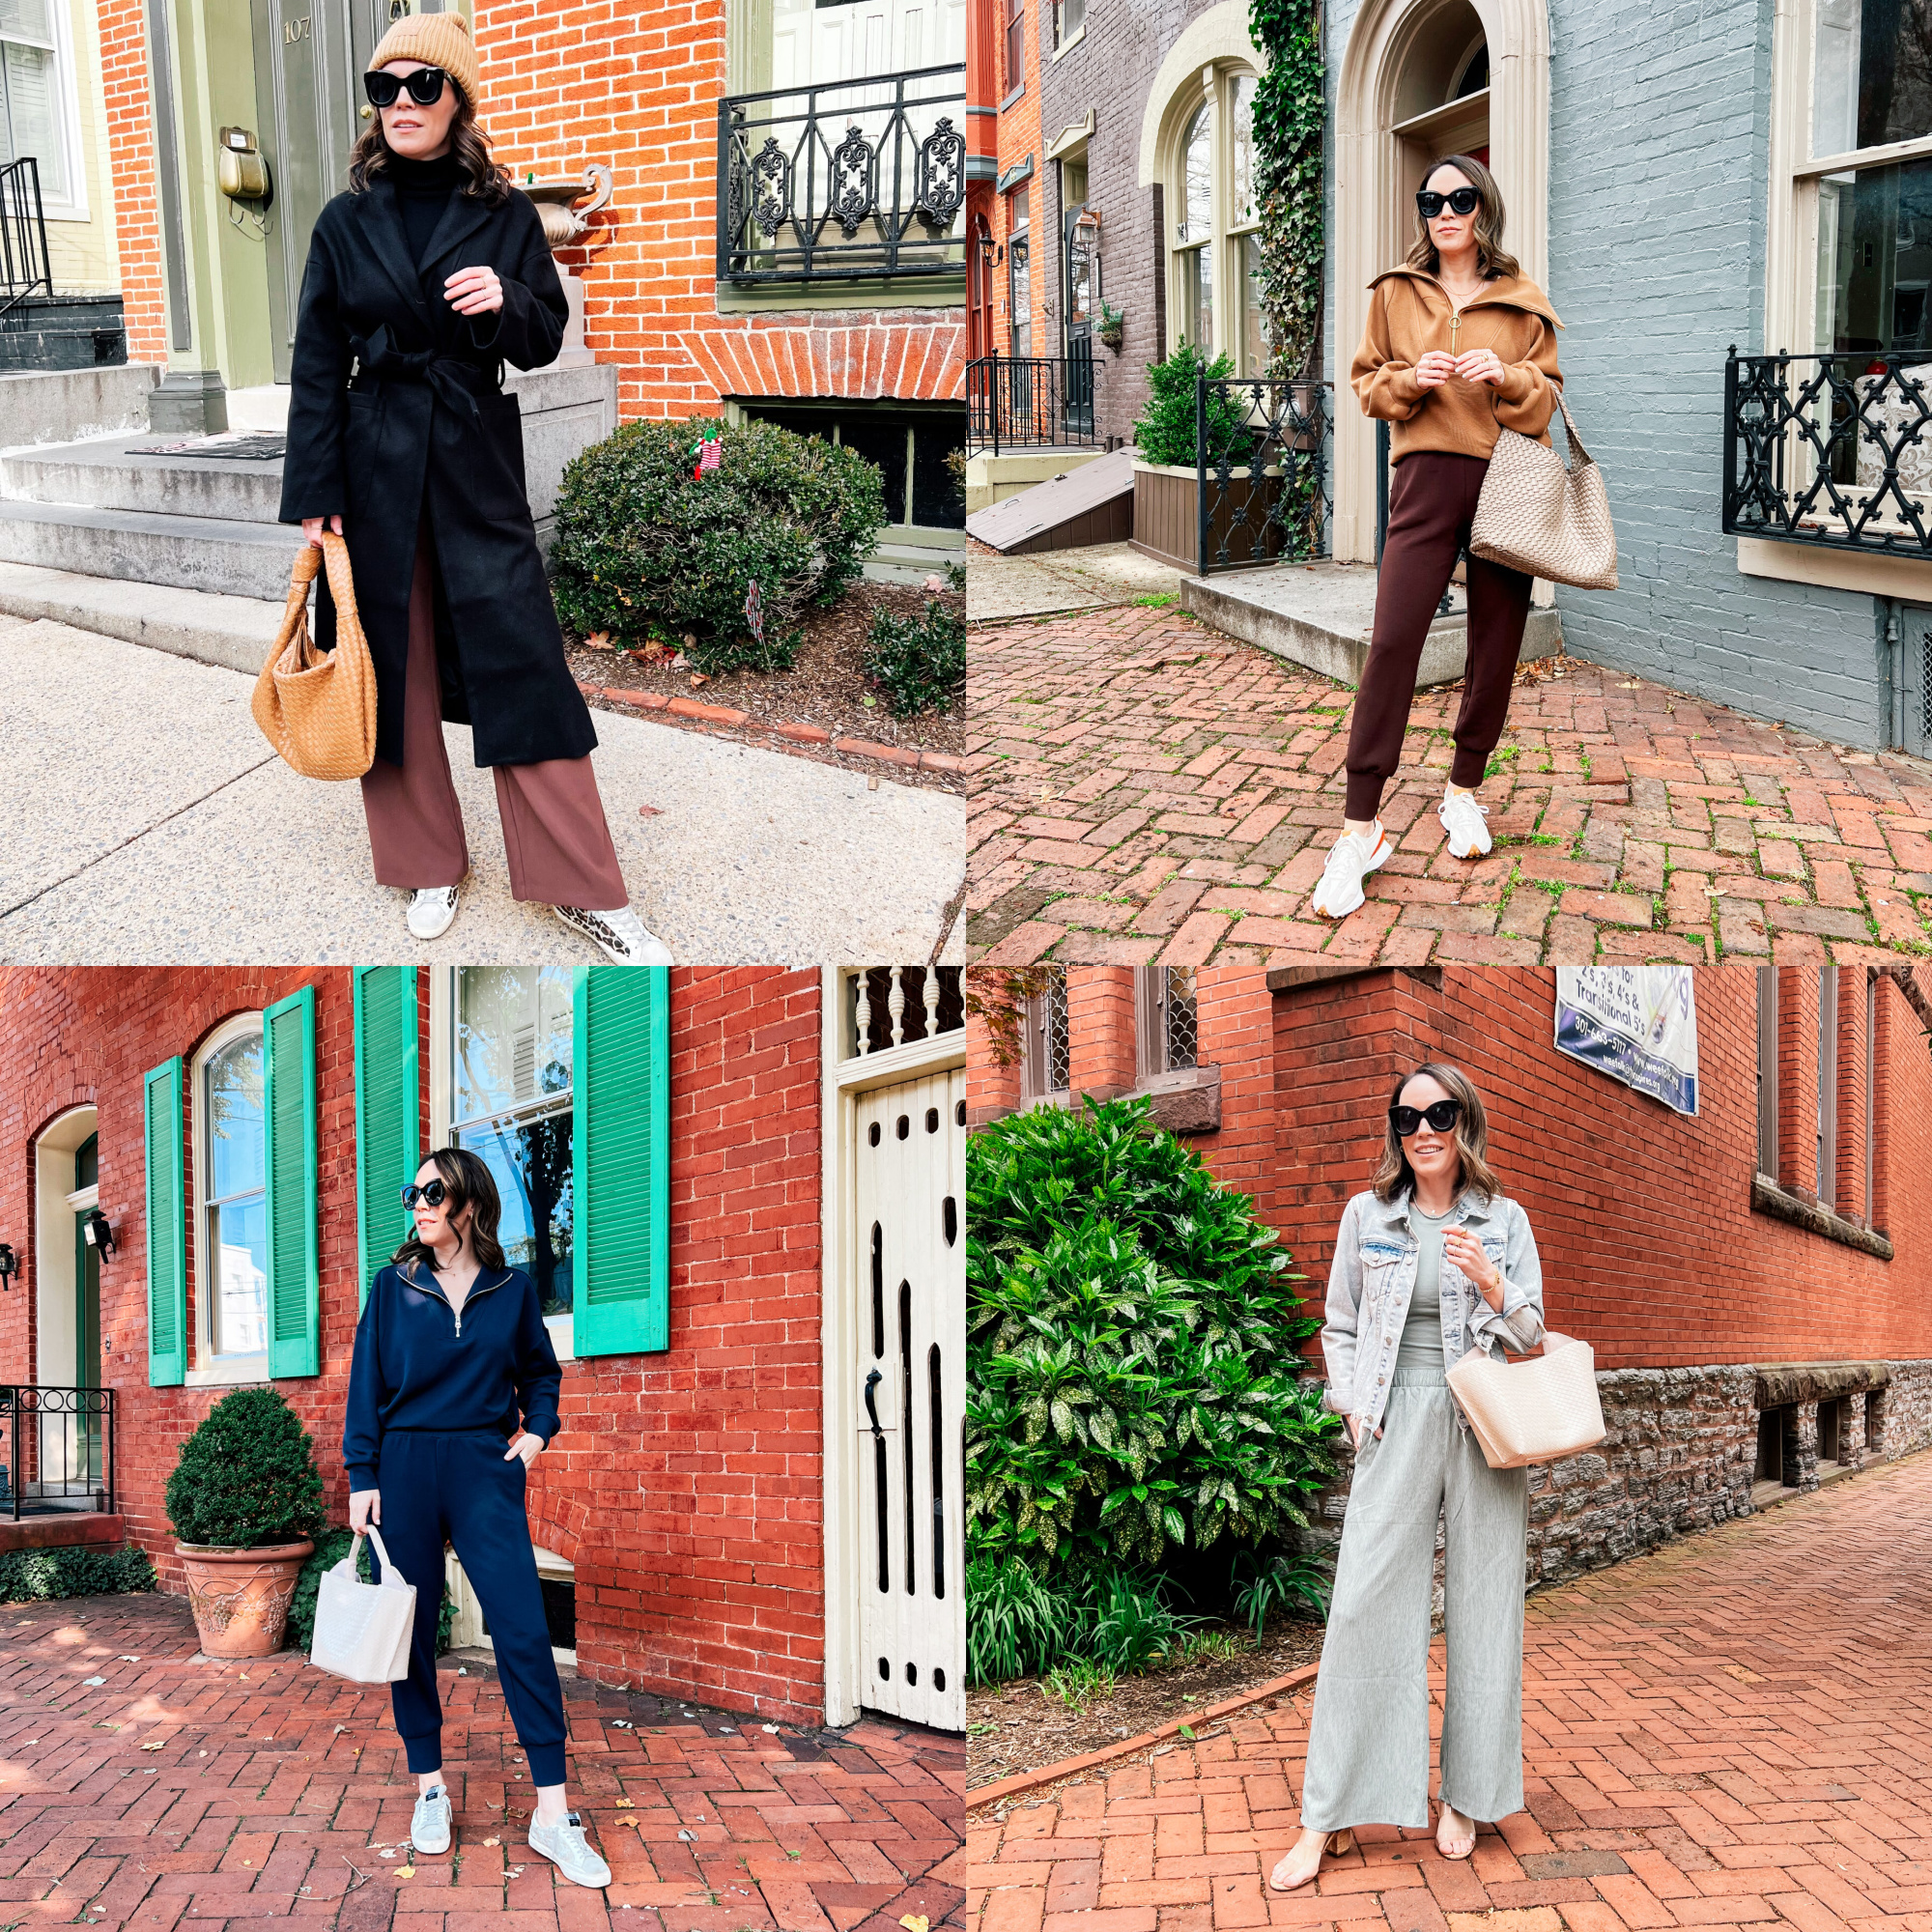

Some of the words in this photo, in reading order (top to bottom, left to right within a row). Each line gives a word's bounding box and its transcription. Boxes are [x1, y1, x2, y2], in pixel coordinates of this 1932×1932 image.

[283, 15, 311, 44] 107
[1576, 978, 1632, 1028] Transitional
[1634, 1015, 1646, 1037] 5's
[1617, 983, 1631, 1006] 4's
[1632, 993, 1640, 1012] &
[1575, 1015, 1627, 1056] 301-663-5117
